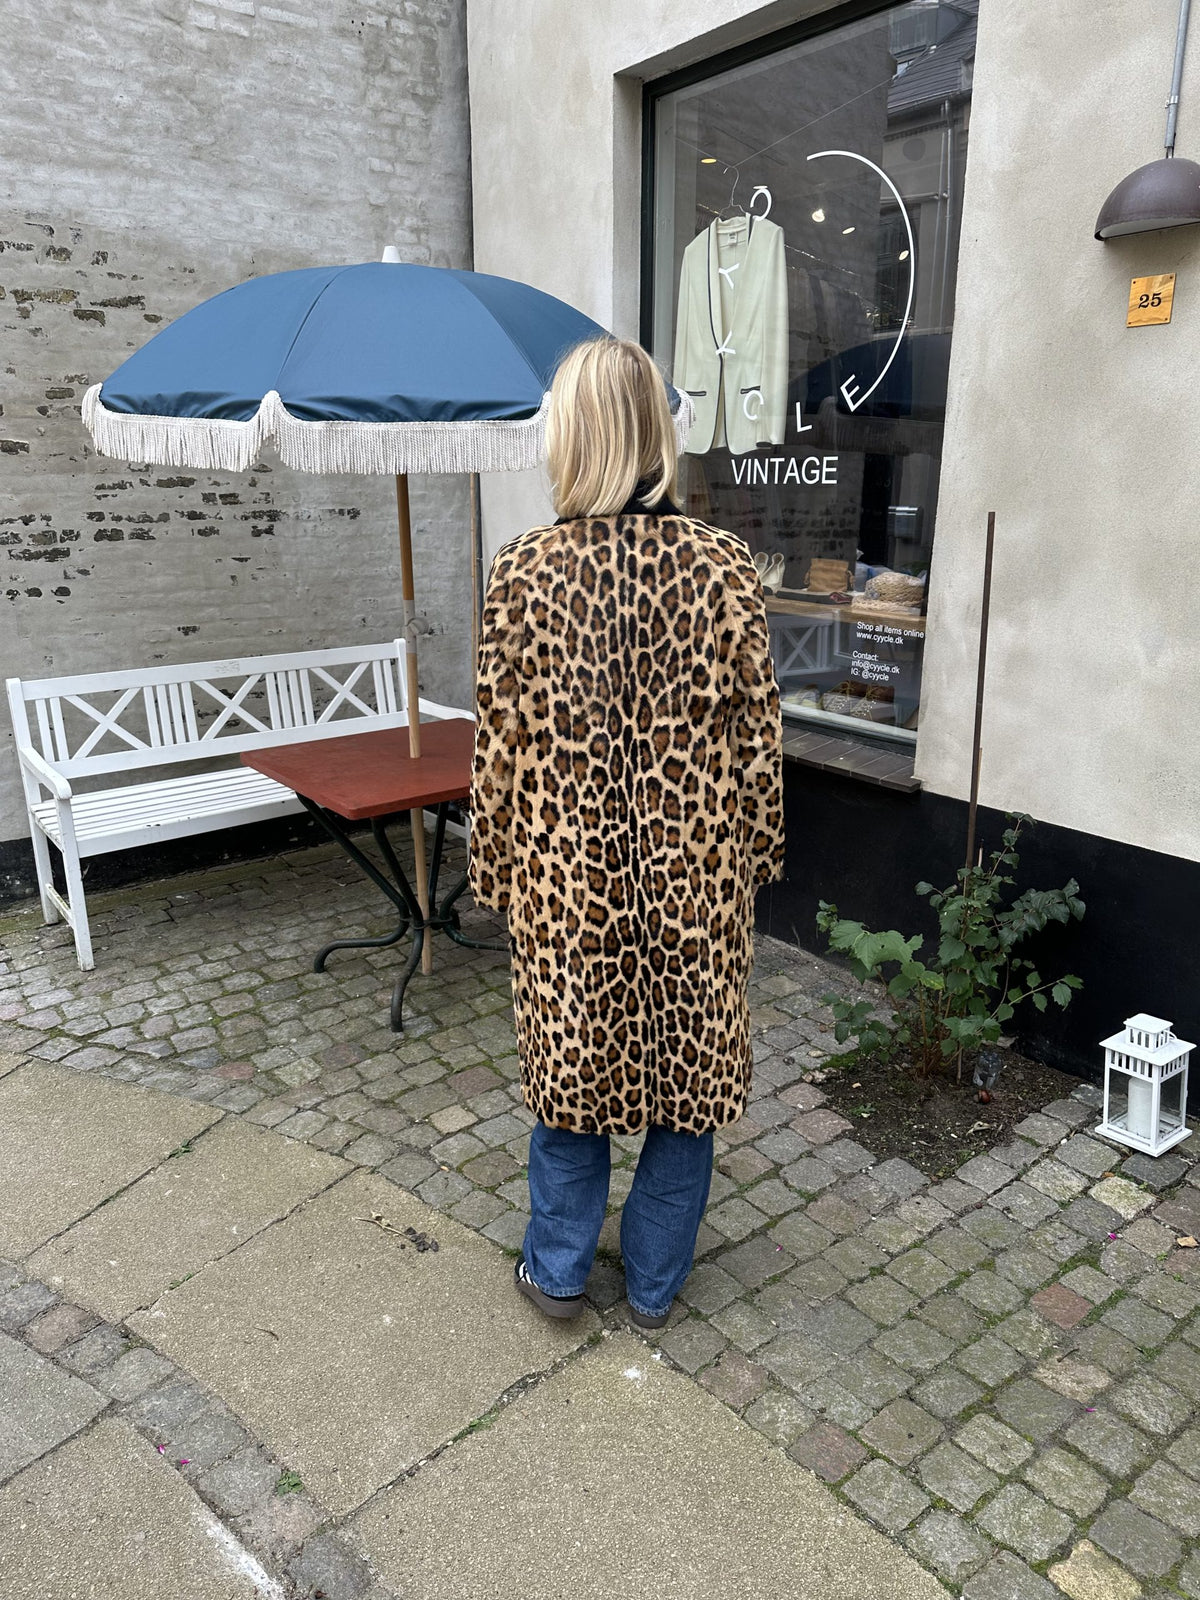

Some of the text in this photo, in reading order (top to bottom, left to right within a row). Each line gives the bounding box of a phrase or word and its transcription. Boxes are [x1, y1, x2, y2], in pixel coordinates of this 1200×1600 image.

[1138, 292, 1162, 309] 25
[731, 456, 839, 485] VINTAGE
[857, 621, 925, 639] Shop all items online
[856, 632, 904, 644] www.cyycle.dk
[852, 650, 879, 661] Contact:
[850, 667, 890, 681] IG: @cyycle
[851, 660, 901, 674] info@cyycle.dk
